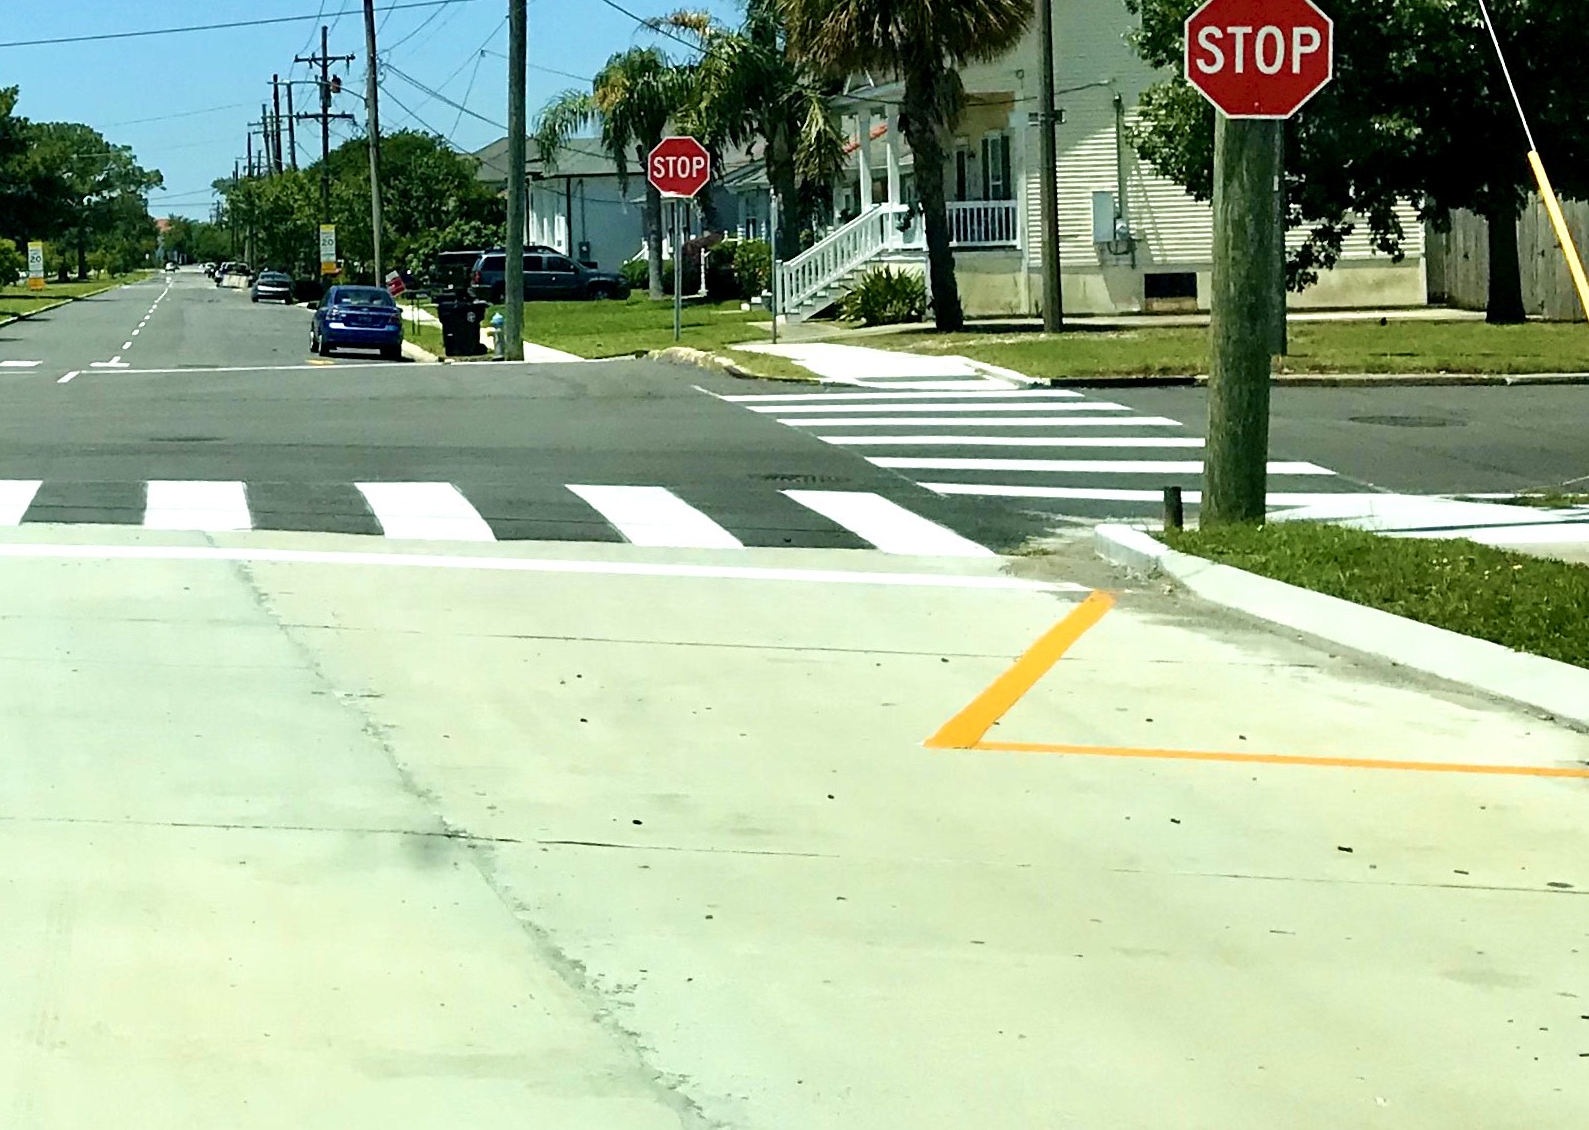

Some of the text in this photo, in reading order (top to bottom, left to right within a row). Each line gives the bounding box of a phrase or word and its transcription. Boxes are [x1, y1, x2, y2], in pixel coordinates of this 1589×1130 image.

[1196, 25, 1321, 75] STOP
[653, 156, 705, 178] STOP
[30, 255, 41, 263] 20
